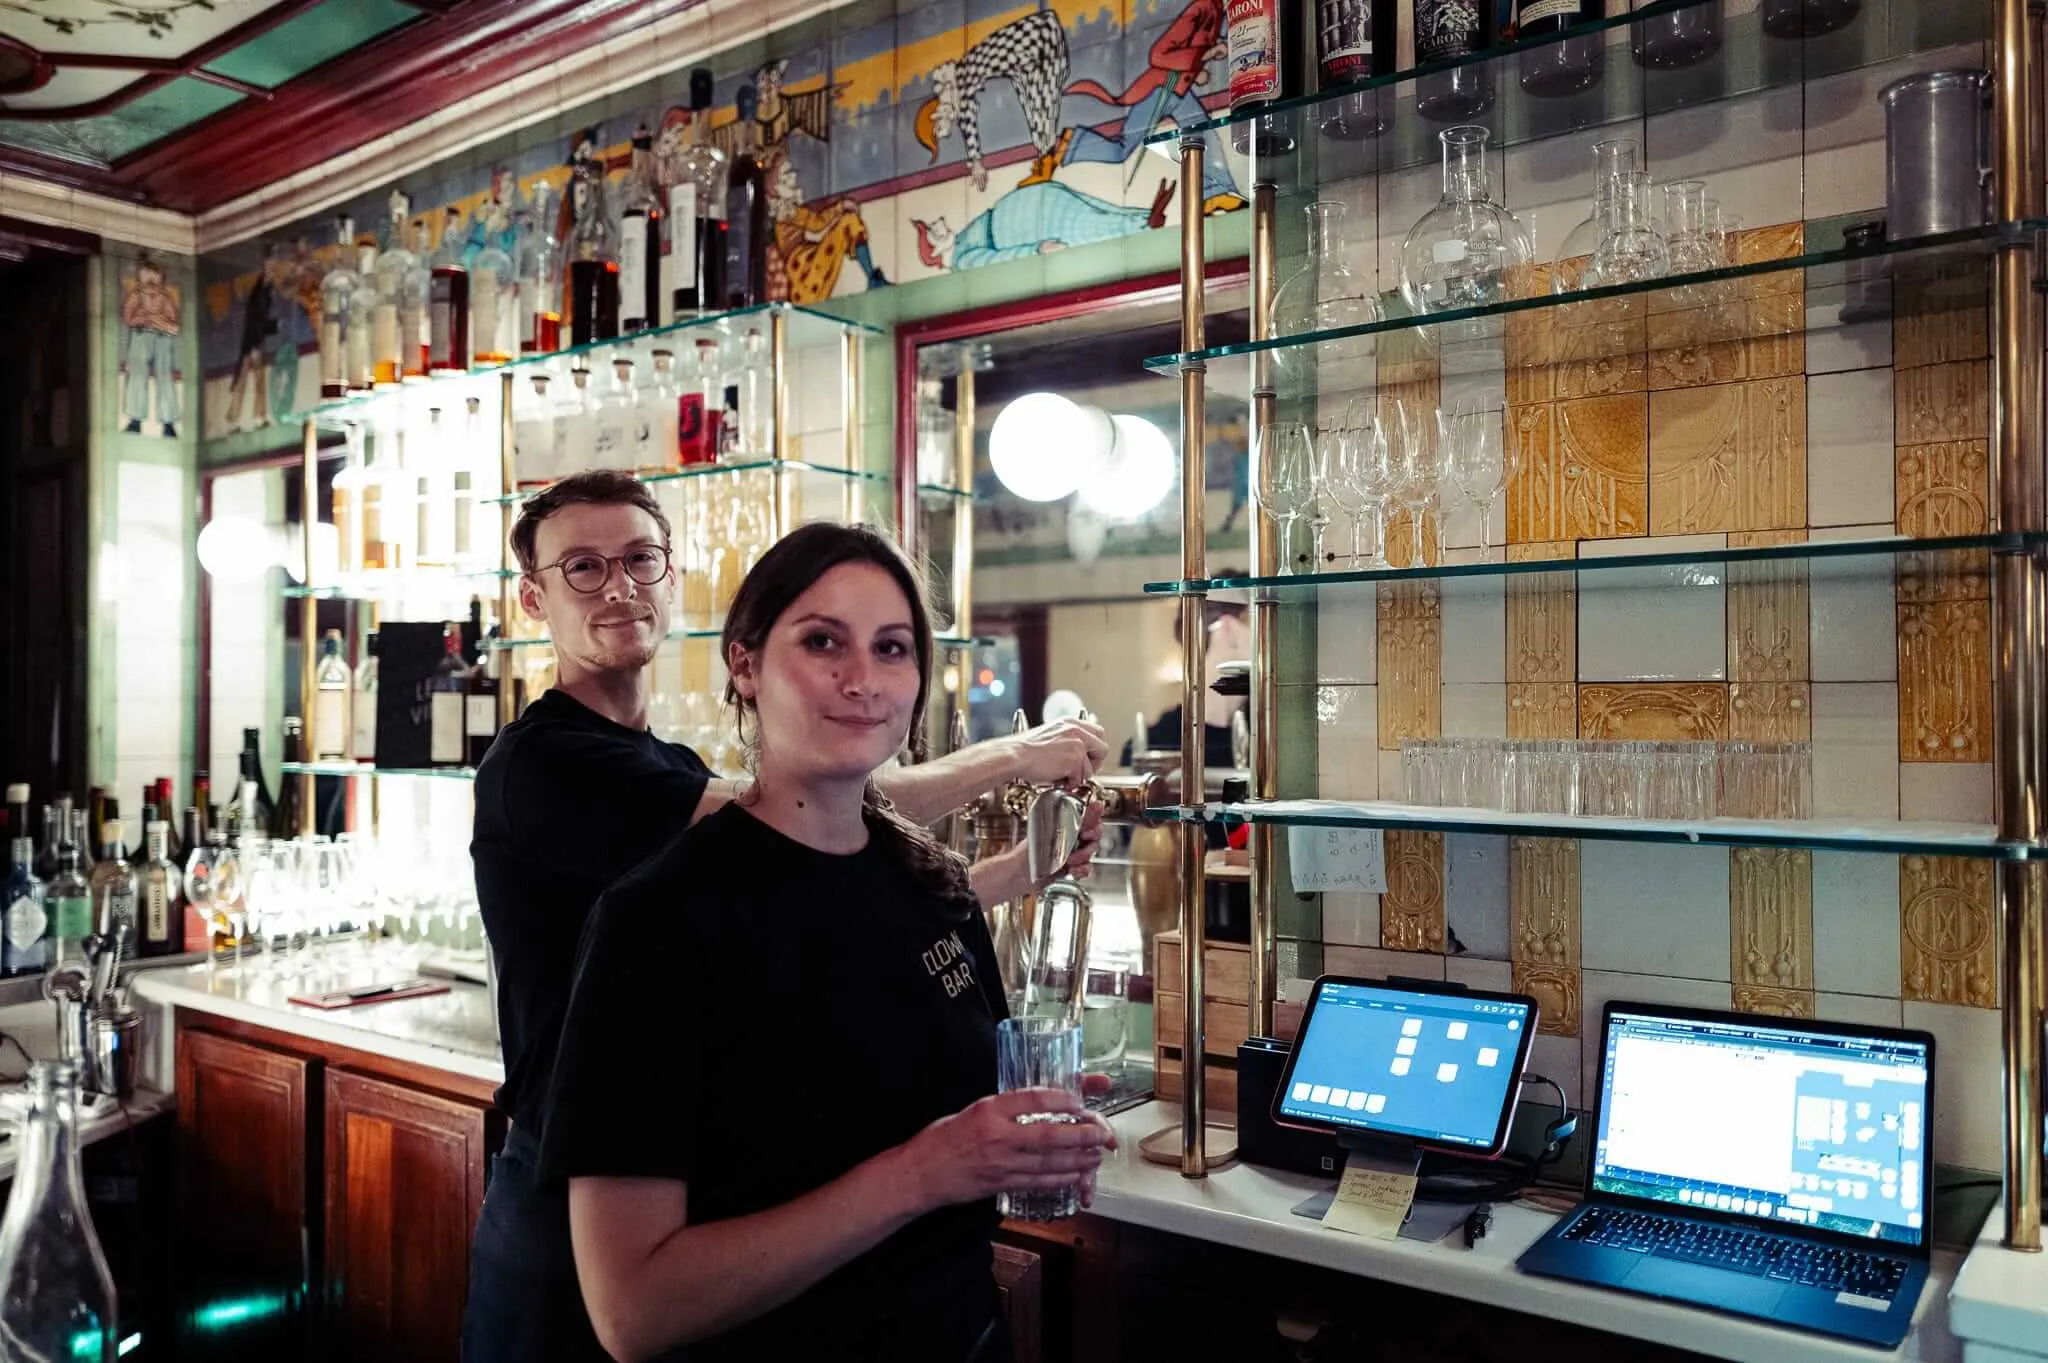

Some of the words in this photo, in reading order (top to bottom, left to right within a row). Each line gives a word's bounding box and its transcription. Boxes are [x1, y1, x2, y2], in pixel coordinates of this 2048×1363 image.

[1323, 55, 1361, 72] ARONI
[922, 930, 966, 976] CLOWN
[942, 962, 976, 998] BAR
